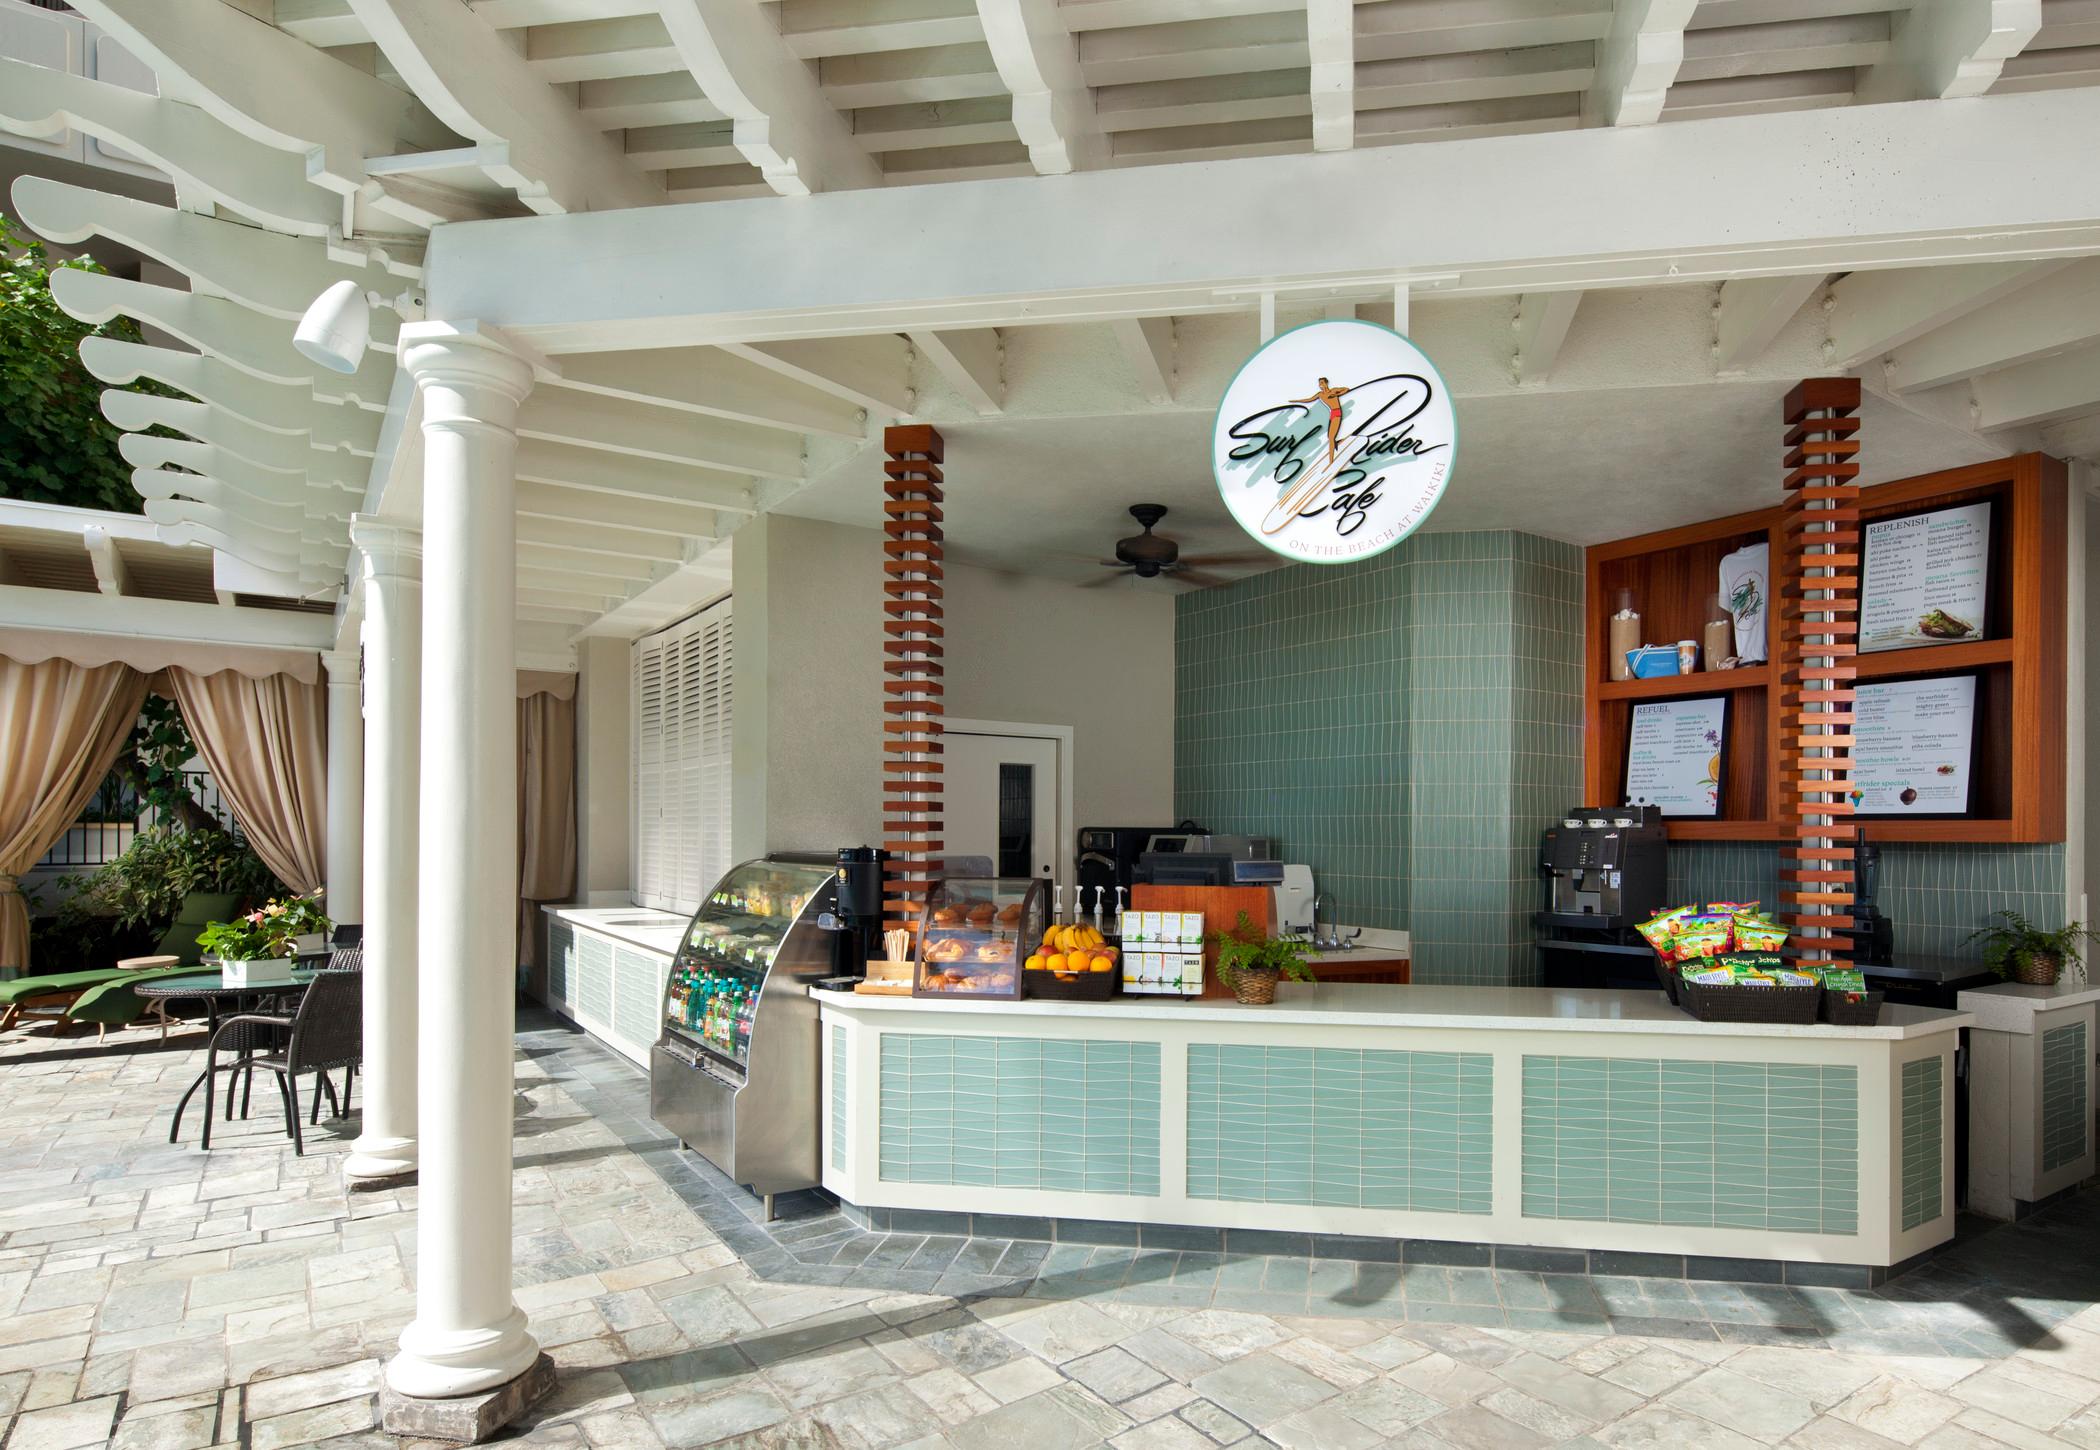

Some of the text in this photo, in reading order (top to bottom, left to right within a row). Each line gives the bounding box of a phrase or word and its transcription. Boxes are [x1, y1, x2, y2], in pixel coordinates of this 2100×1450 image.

[1229, 373, 1448, 483] Surf Rider
[1289, 462, 1445, 555] ON THE BEACH AT WAIKIKI
[1870, 517, 1929, 535] REPLENISH
[1636, 705, 1670, 714] REFUEL
[1697, 970, 1728, 982] MAUI STYLE
[1784, 974, 1812, 986] MAUI STYLE
